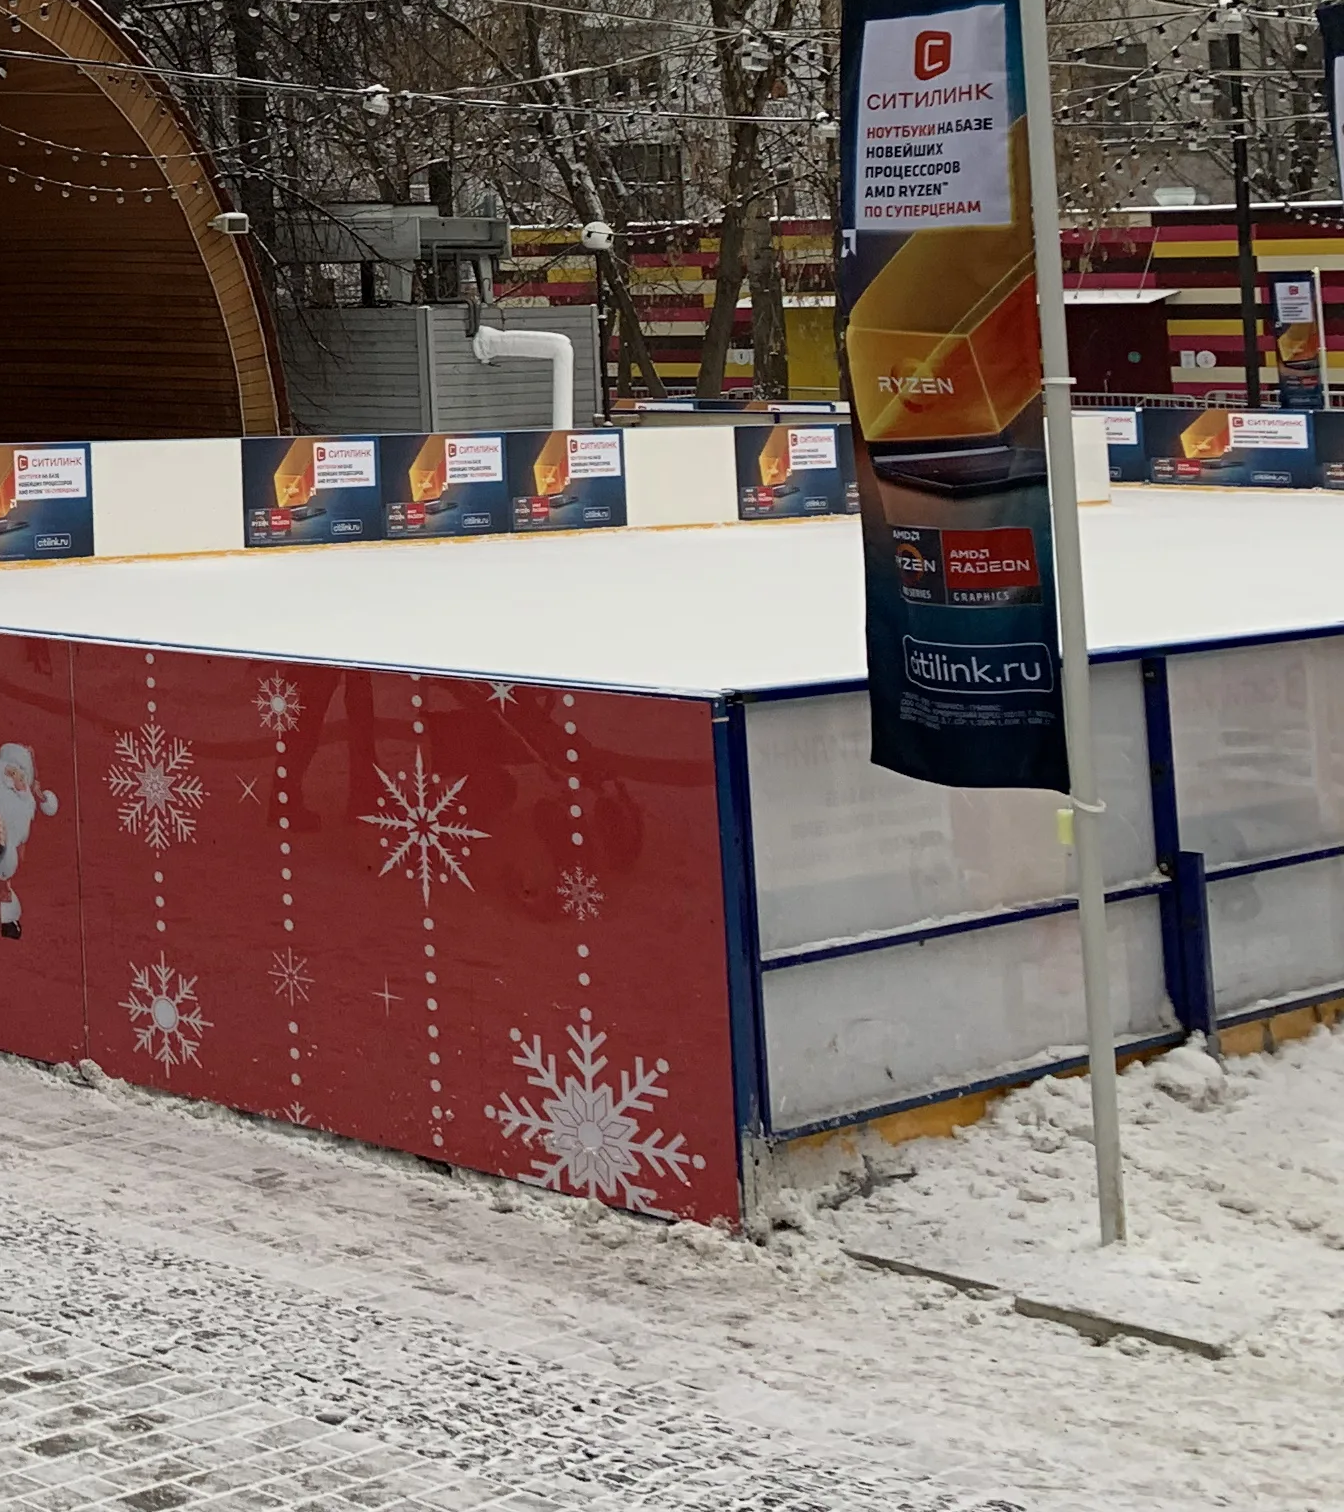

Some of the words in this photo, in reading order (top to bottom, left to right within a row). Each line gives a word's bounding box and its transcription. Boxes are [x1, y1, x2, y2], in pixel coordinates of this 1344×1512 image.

[867, 83, 993, 111] СИТИЛИНК
[867, 124, 936, 139] НОУТБУКИ
[938, 121, 954, 134] НА
[955, 117, 993, 132] БАЗЕ
[866, 142, 943, 159] НОВЕЙШИХ
[865, 160, 960, 180] ПРОЦЕССОРОВ
[865, 185, 894, 199] AMD
[865, 205, 882, 218] ПО
[886, 200, 981, 218] СУПЕРЦЕНАМ
[878, 376, 954, 394] RYZEN
[31, 457, 82, 467] СИТИЛИНК
[950, 549, 978, 559] AMD
[895, 555, 936, 573] YZEN
[950, 559, 1031, 574] RADEON
[954, 591, 1010, 602] GRAPHICS
[911, 650, 1041, 683] citilink.ru
